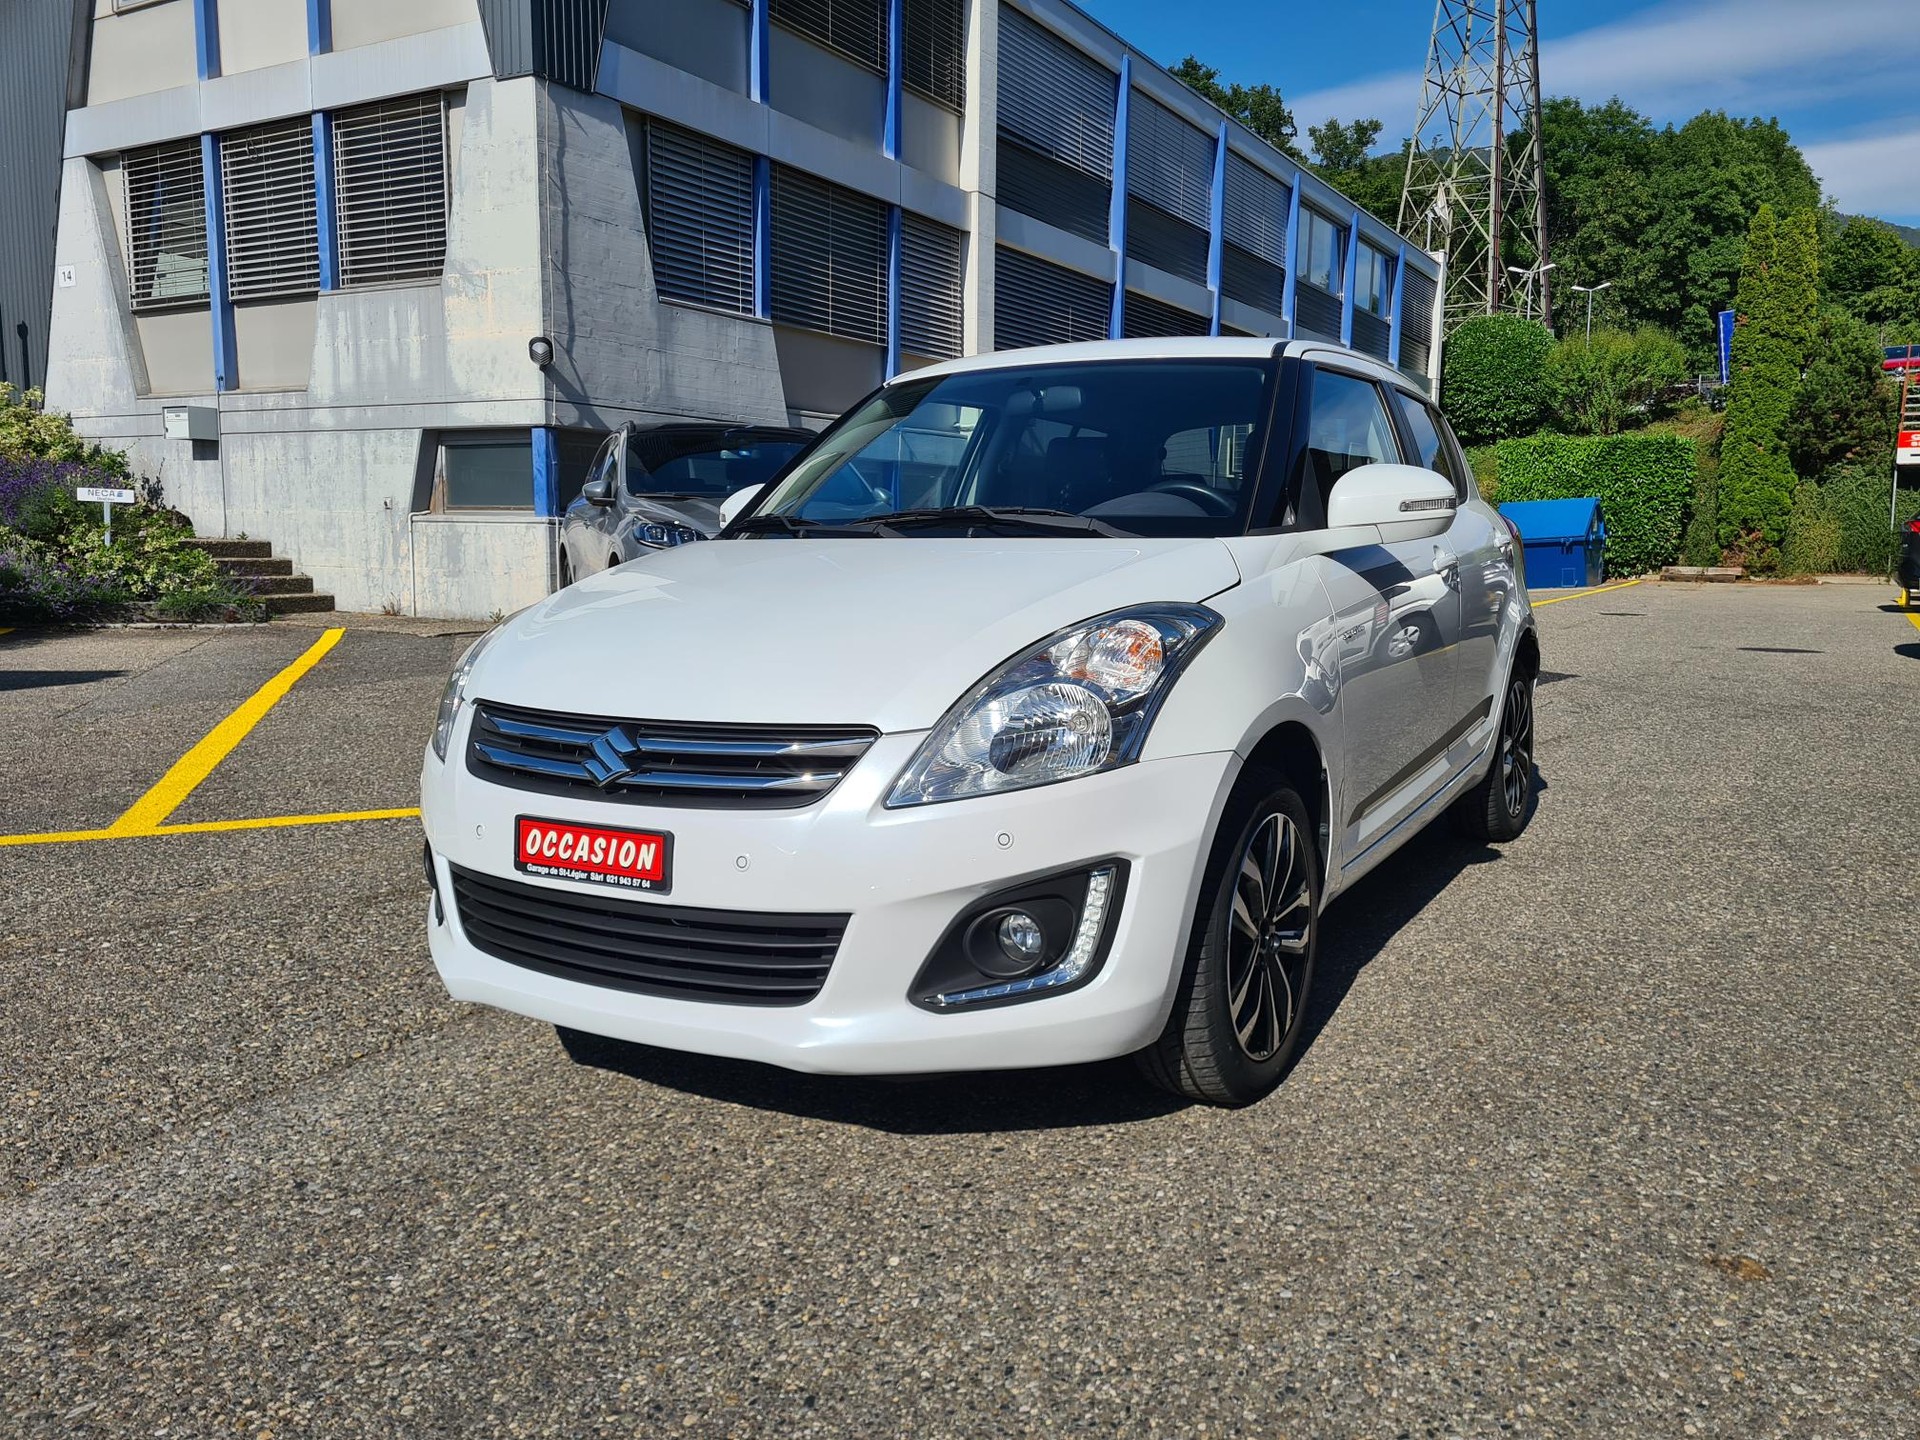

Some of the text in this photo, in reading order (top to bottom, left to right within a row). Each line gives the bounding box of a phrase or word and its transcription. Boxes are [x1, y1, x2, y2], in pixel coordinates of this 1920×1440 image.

[62, 270, 72, 282] 14
[526, 828, 656, 871] OCCASION
[527, 863, 549, 875] Garage
[550, 867, 558, 875] de
[606, 874, 618, 884] 021
[619, 876, 632, 886] 943
[632, 878, 641, 887] 57
[641, 879, 650, 888] 64
